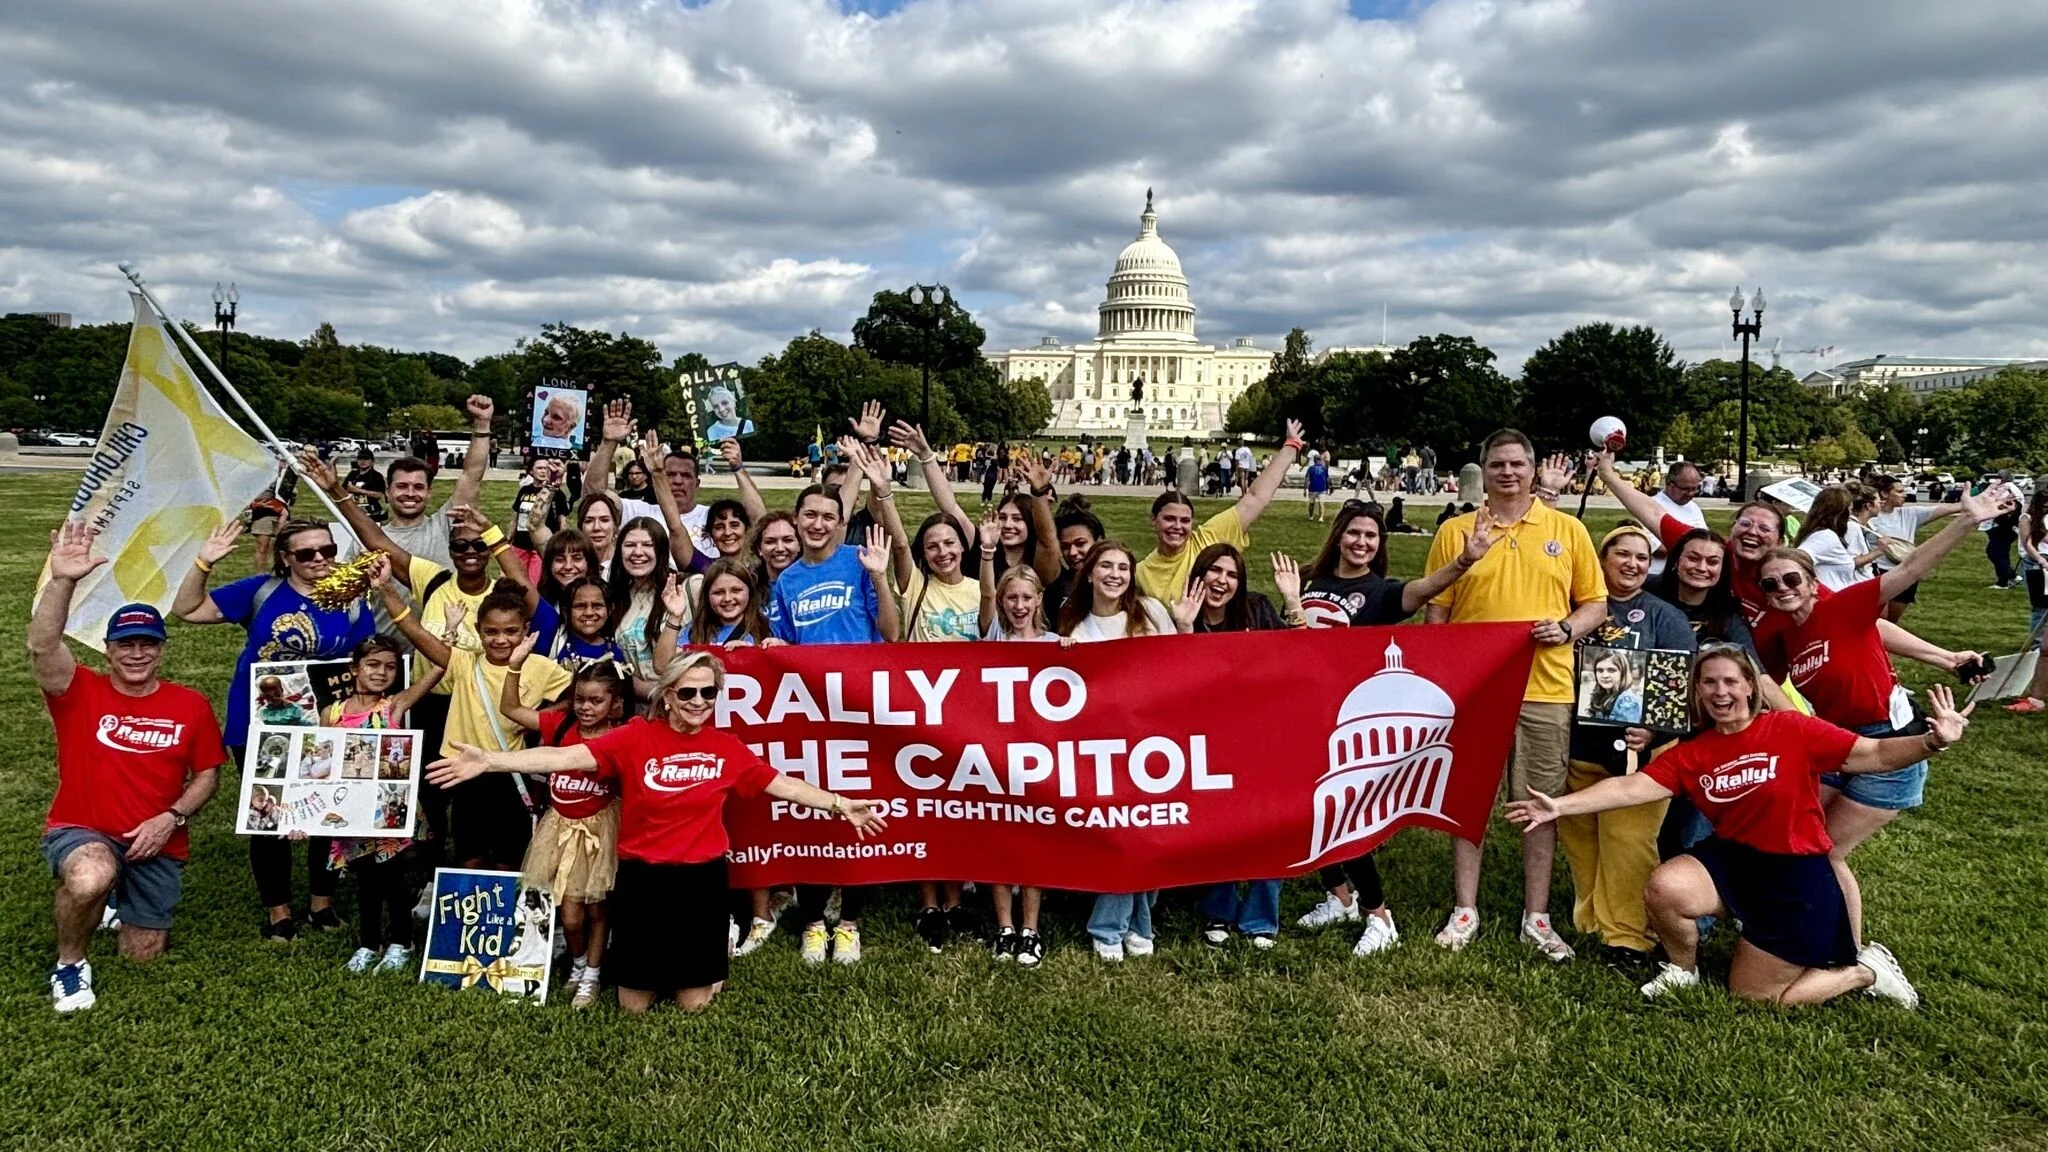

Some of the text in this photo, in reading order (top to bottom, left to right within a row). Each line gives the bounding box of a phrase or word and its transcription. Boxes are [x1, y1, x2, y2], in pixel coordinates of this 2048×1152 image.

[542, 377, 577, 389] LONG
[680, 367, 725, 387] ALLY
[537, 447, 567, 458] LIVE
[798, 586, 854, 615] Rally!
[1791, 640, 1830, 677] Rally!
[715, 666, 1087, 728] RALLY TO
[115, 724, 185, 747] Rally!
[660, 758, 725, 781] Rally!
[747, 735, 1233, 797] HE CAPITOL
[1716, 755, 1779, 790] Rally!
[917, 799, 1056, 825] FIGHTING
[1065, 802, 1189, 828] CANCER
[439, 883, 504, 925] Fight
[486, 914, 513, 925] Like a
[460, 926, 503, 956] Kid
